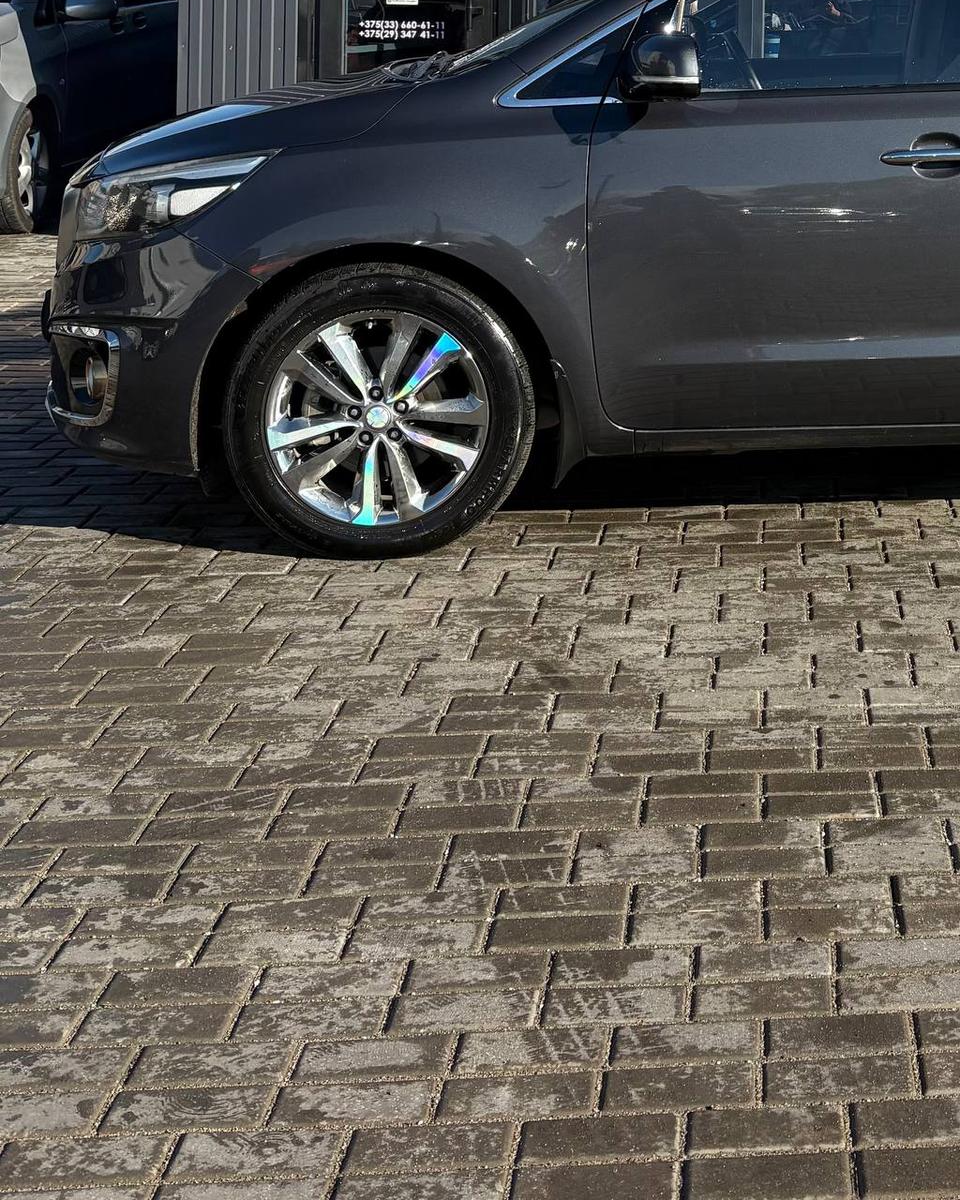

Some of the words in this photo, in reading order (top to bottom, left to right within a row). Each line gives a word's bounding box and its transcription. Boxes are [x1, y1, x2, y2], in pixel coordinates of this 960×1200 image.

[358, 20, 399, 31] +375(33)
[400, 21, 445, 30] 660-61-11
[358, 30, 399, 41] +375(29)
[400, 30, 417, 39] 347
[419, 30, 445, 40] 41-11
